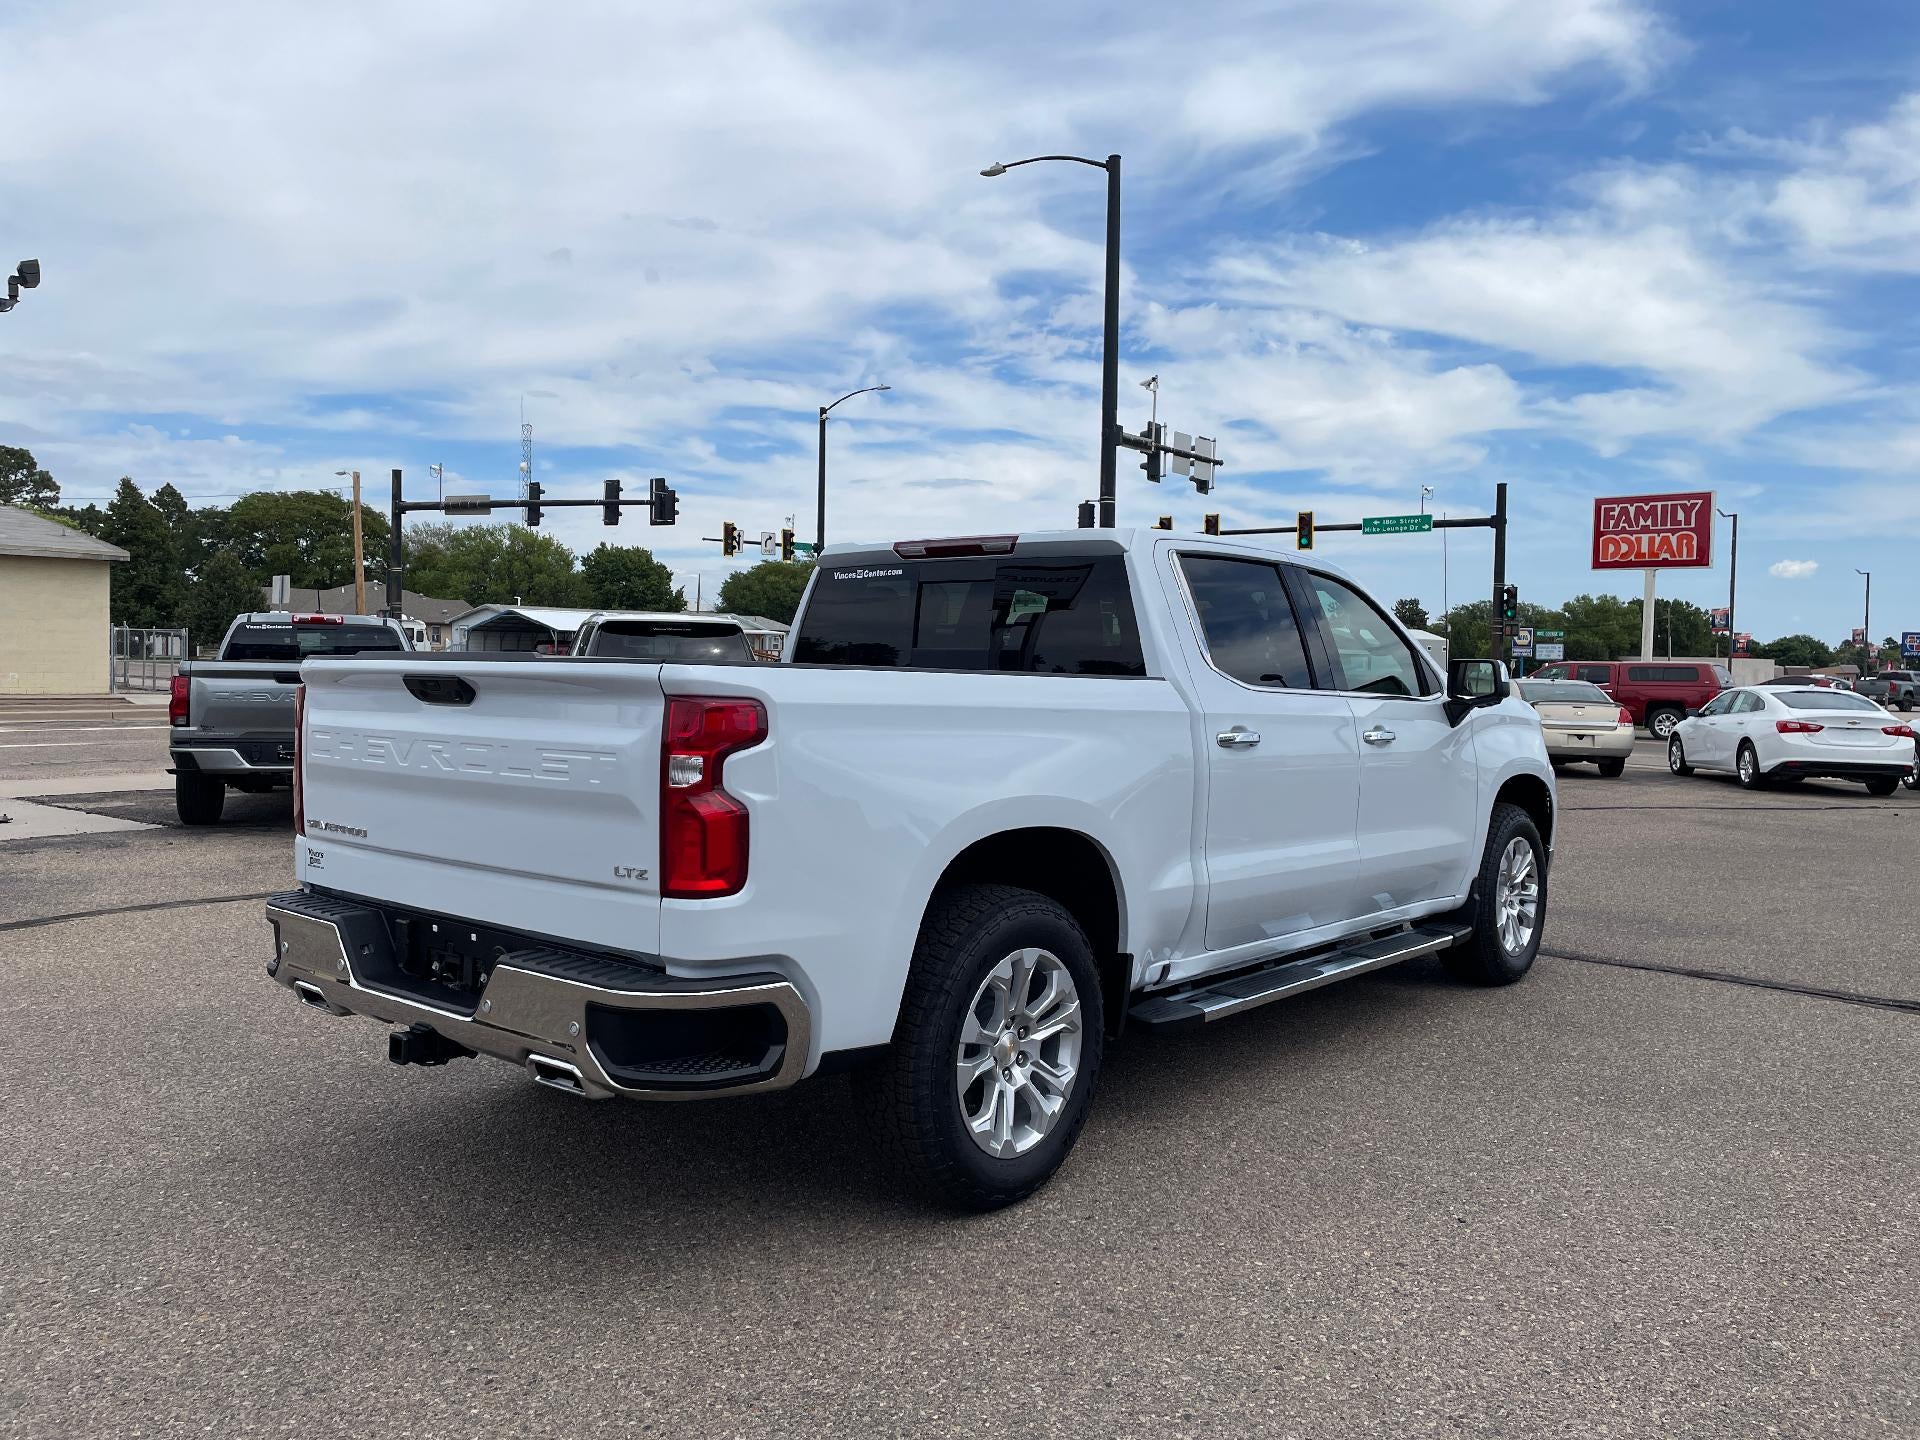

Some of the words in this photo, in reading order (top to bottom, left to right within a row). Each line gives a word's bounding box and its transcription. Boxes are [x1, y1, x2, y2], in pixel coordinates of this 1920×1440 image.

[1601, 500, 1703, 531] FAMILY
[1600, 531, 1697, 562] DOLLAR
[311, 729, 617, 784] CHEVROLET
[613, 865, 649, 881] LTZ
